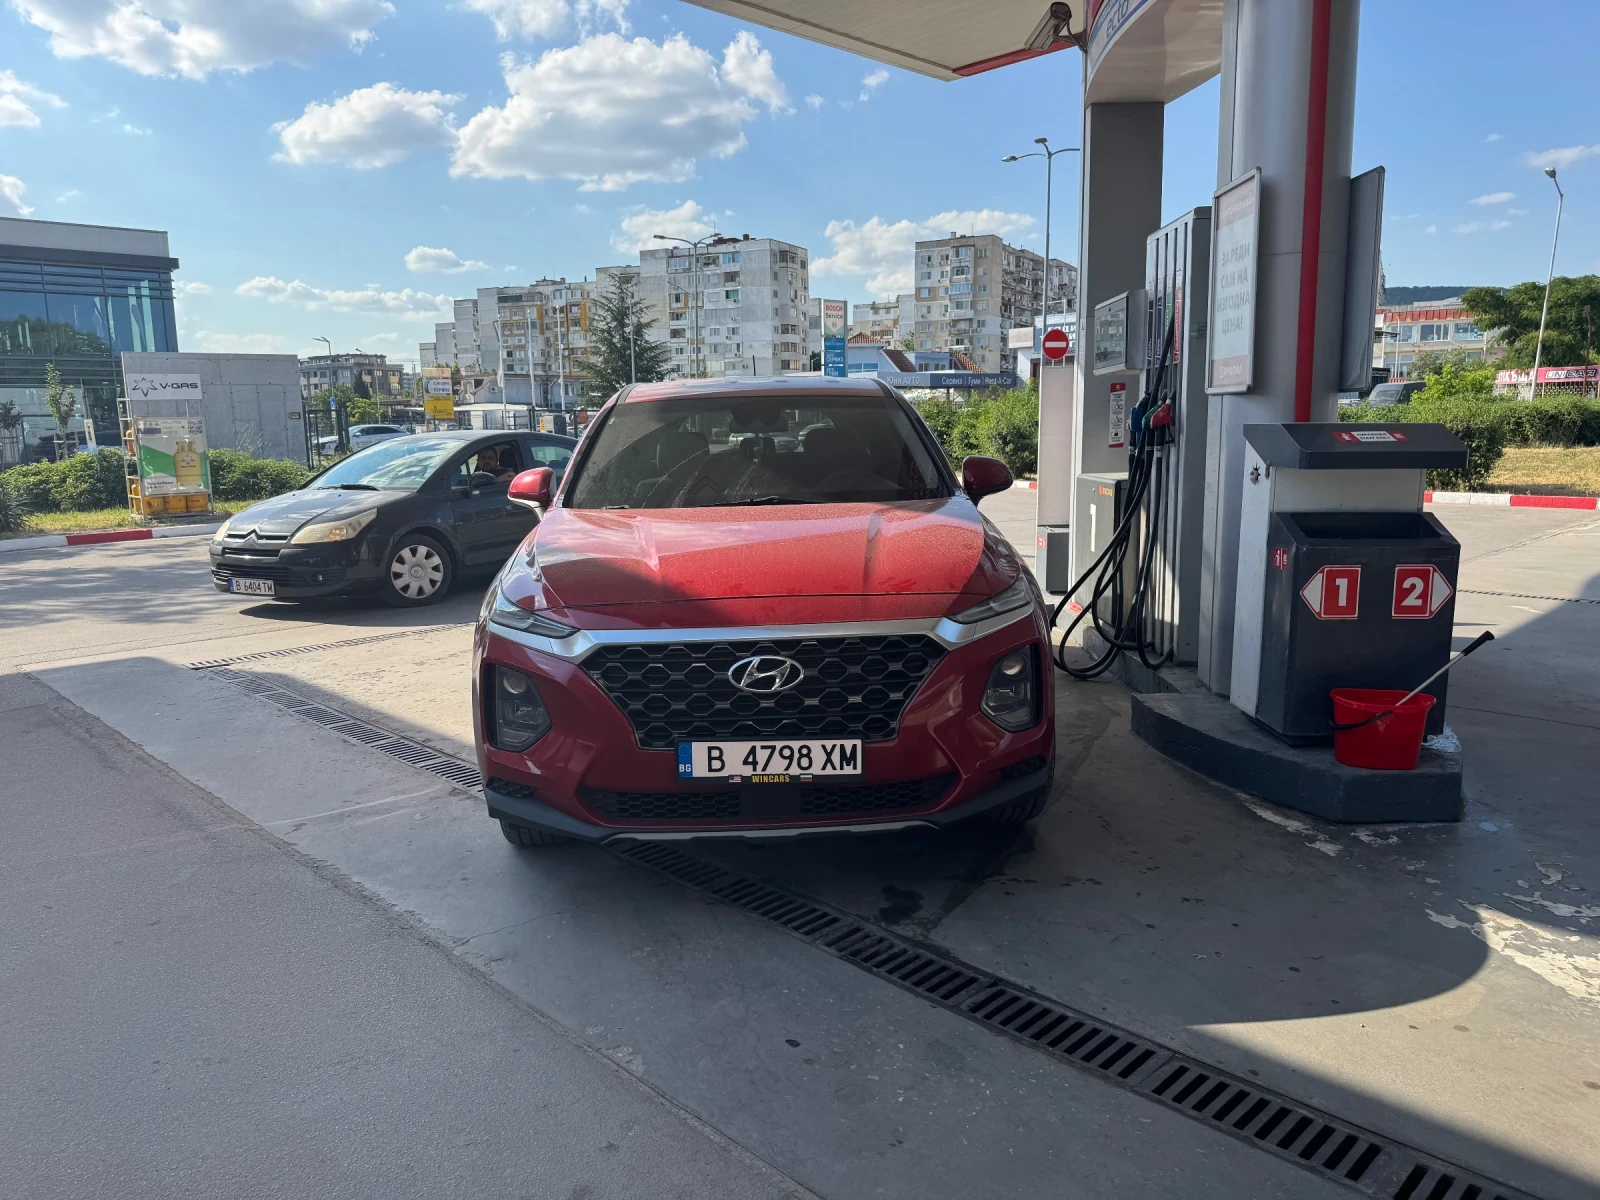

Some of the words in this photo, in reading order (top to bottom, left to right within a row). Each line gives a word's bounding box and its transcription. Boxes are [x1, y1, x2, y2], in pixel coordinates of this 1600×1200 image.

[1221, 241, 1250, 267] ЗАРЕДИ
[1221, 271, 1236, 289] САМ
[1237, 267, 1248, 285] НА
[825, 304, 843, 312] BOSCH
[1217, 290, 1250, 313] ИЗГОДНА
[1221, 316, 1243, 335] ЦЕНА!
[903, 376, 920, 385] АУТО
[941, 376, 963, 386] Сервиз
[968, 376, 981, 387] Гуми
[1545, 369, 1597, 379] UNICAR
[235, 580, 241, 591] B
[244, 580, 261, 592] 6404
[262, 582, 273, 593] TM
[1335, 577, 1348, 607] 1
[1400, 576, 1424, 606] 2
[707, 745, 726, 773] B
[742, 744, 813, 772] 4798
[820, 743, 858, 771] XM
[679, 764, 692, 772] BG
[751, 774, 790, 783] WINCARS
